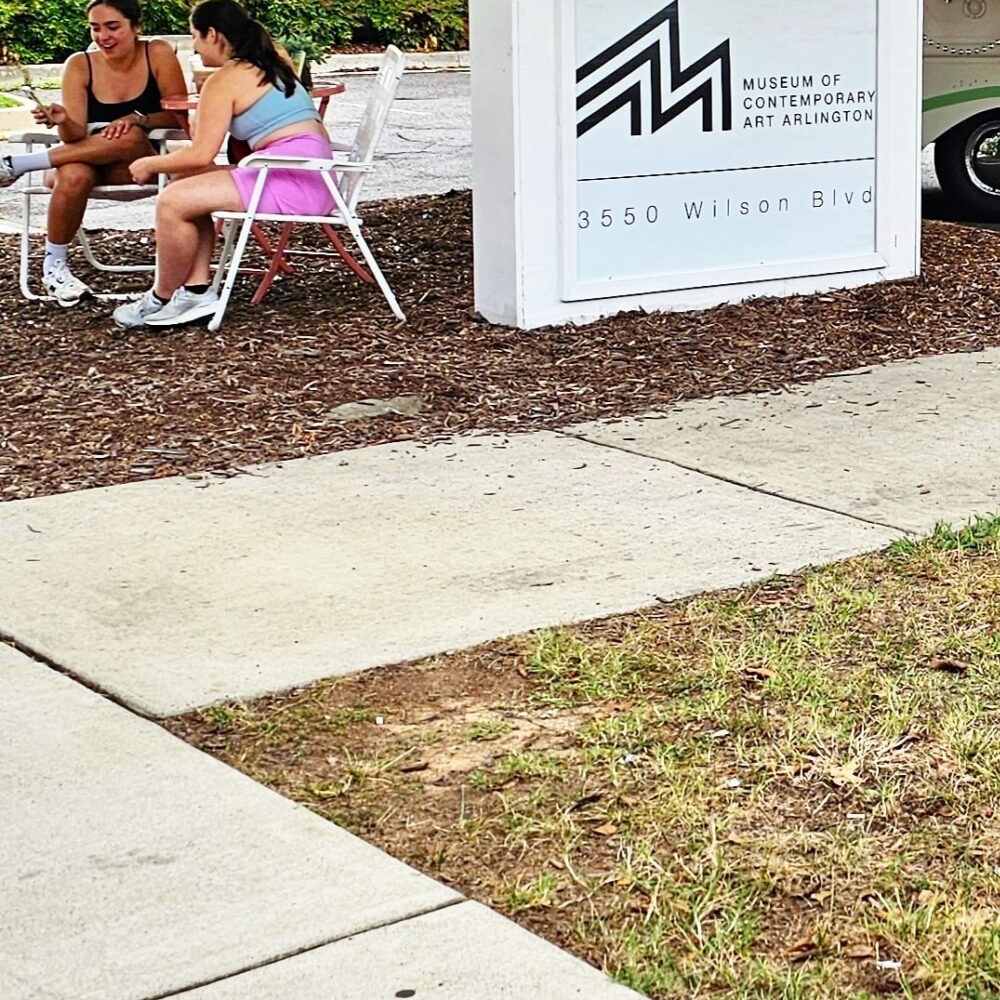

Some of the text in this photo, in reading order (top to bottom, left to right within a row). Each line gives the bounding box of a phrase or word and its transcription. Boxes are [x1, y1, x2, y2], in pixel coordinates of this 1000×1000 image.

[743, 73, 842, 91] MUSEUM OF
[743, 90, 876, 110] CONTEMPORARY
[743, 109, 873, 129] ART ARLINGTON
[578, 187, 873, 229] 3550 Wilson Blvd
